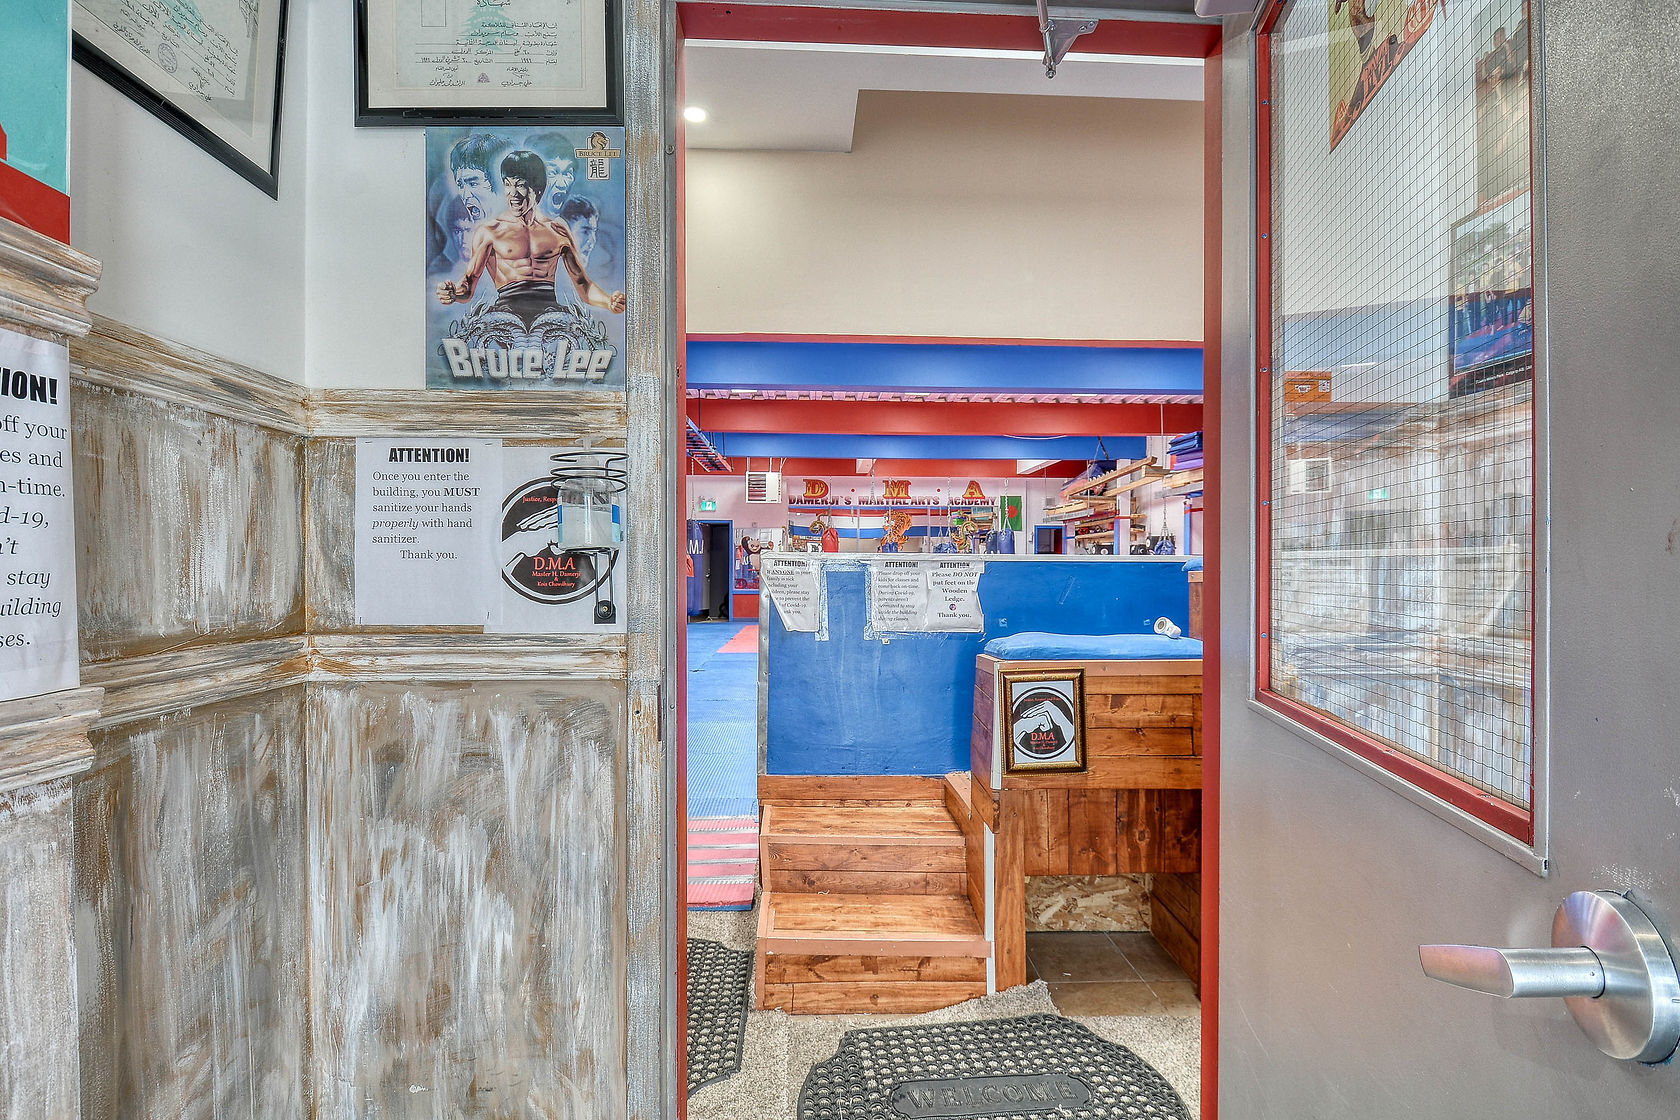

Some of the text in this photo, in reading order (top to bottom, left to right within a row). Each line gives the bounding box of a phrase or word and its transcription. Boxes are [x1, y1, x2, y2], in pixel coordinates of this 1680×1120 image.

[590, 159, 608, 178] 龍
[441, 338, 613, 379] Bruce Lee
[0, 366, 58, 405] ION!
[24, 422, 67, 440] your
[28, 451, 63, 468] and
[388, 447, 470, 463] ATTENTION!
[372, 471, 470, 483] Once you enter the
[372, 486, 481, 499] building, you MUST
[803, 479, 985, 499] D M A
[858, 495, 909, 506] MARTIAL
[910, 495, 940, 506] ARTS
[949, 495, 996, 506] ACADEMY
[372, 502, 472, 514] sanitize your hands
[372, 518, 473, 530] properly with hand
[372, 534, 420, 544] sanitizer.
[400, 550, 458, 561] Thank you.
[533, 557, 576, 571] D.M.A
[6, 570, 51, 589] stay
[559, 571, 581, 579] Damerji
[1031, 732, 1055, 741] D.M.A
[906, 1080, 1079, 1110] WELCOME
